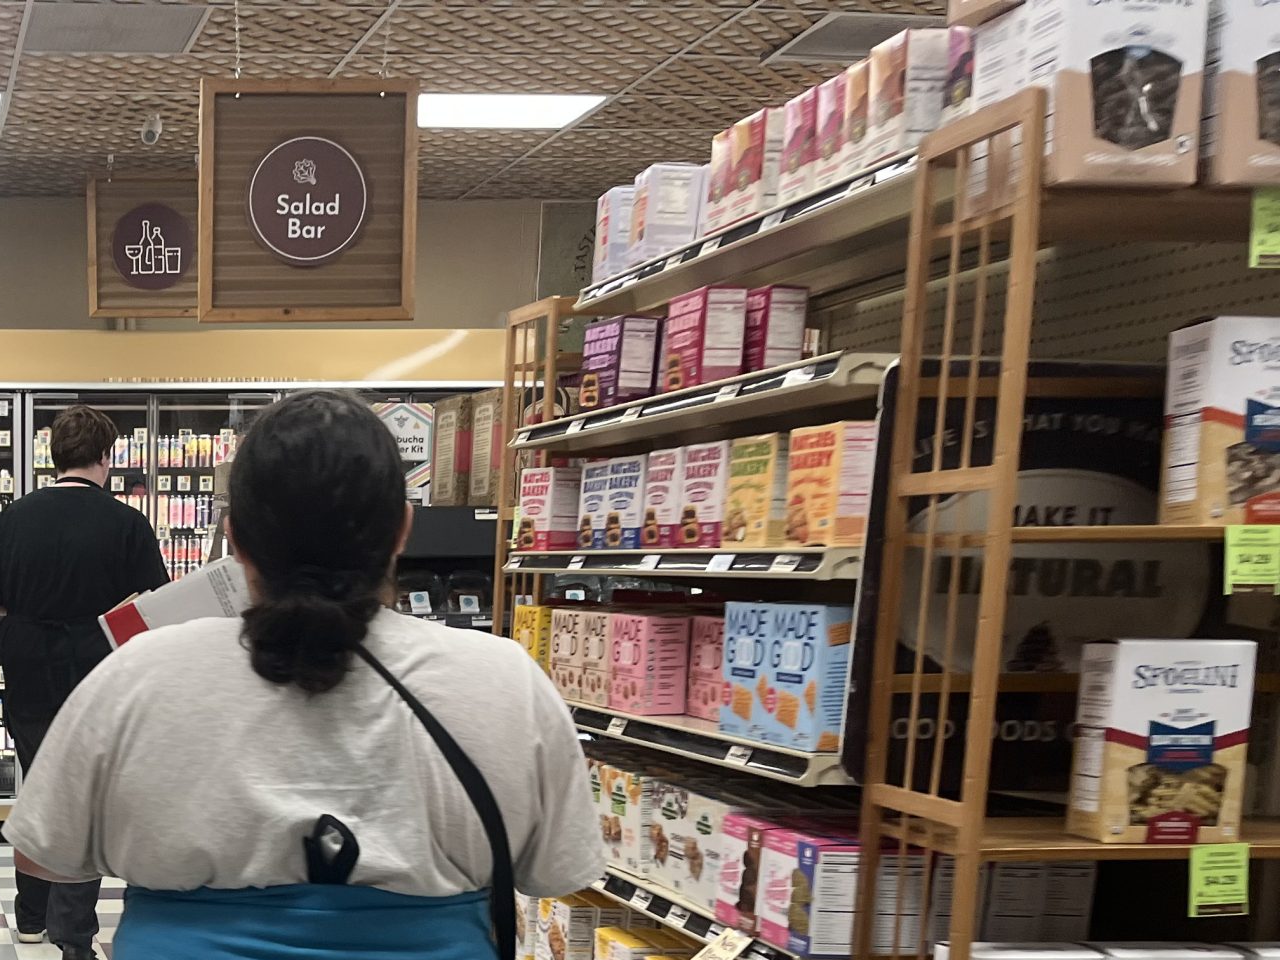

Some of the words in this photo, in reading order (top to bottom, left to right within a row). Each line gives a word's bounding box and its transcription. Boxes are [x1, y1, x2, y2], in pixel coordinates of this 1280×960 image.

[276, 193, 340, 215] Salad
[287, 218, 326, 239] Bar
[1022, 412, 1064, 432] HAT
[411, 445, 424, 454] Kit
[935, 555, 1164, 598] NTURAL
[728, 609, 768, 637] MADE
[774, 610, 818, 640] MADE
[892, 716, 956, 741] OOD
